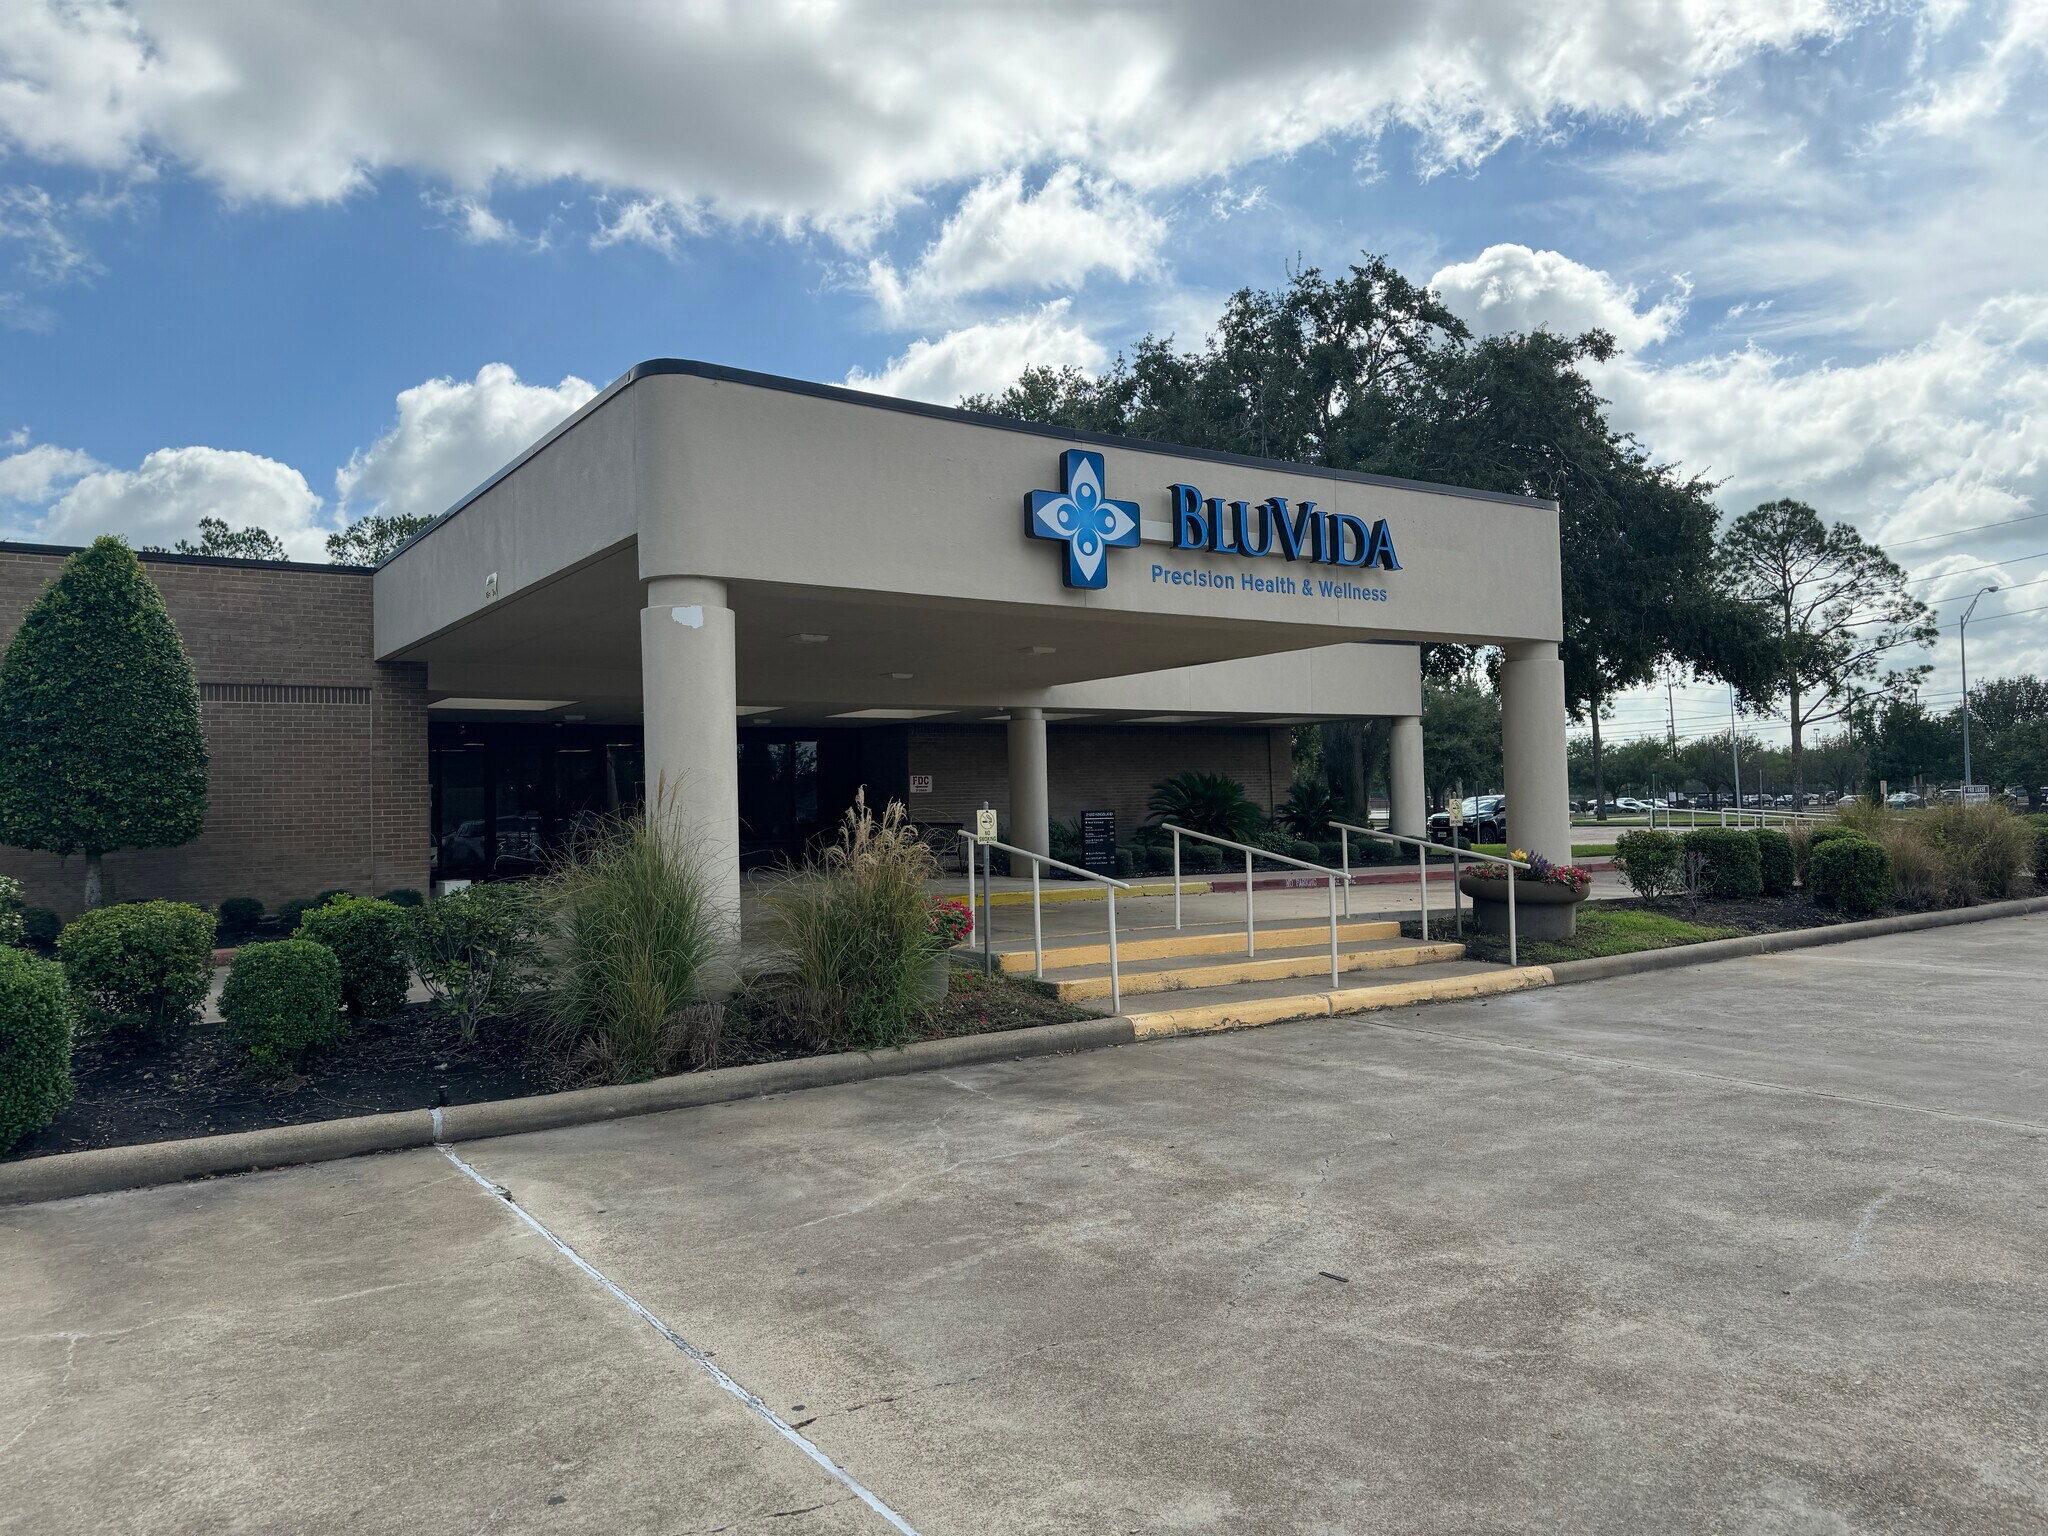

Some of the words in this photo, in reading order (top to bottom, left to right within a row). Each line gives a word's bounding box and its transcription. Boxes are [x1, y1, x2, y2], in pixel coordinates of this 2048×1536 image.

[1152, 564, 1235, 590] Precision
[1241, 572, 1296, 595] Health
[1302, 579, 1314, 597] &
[1318, 580, 1387, 602] Wellness
[913, 776, 929, 785] FDC
